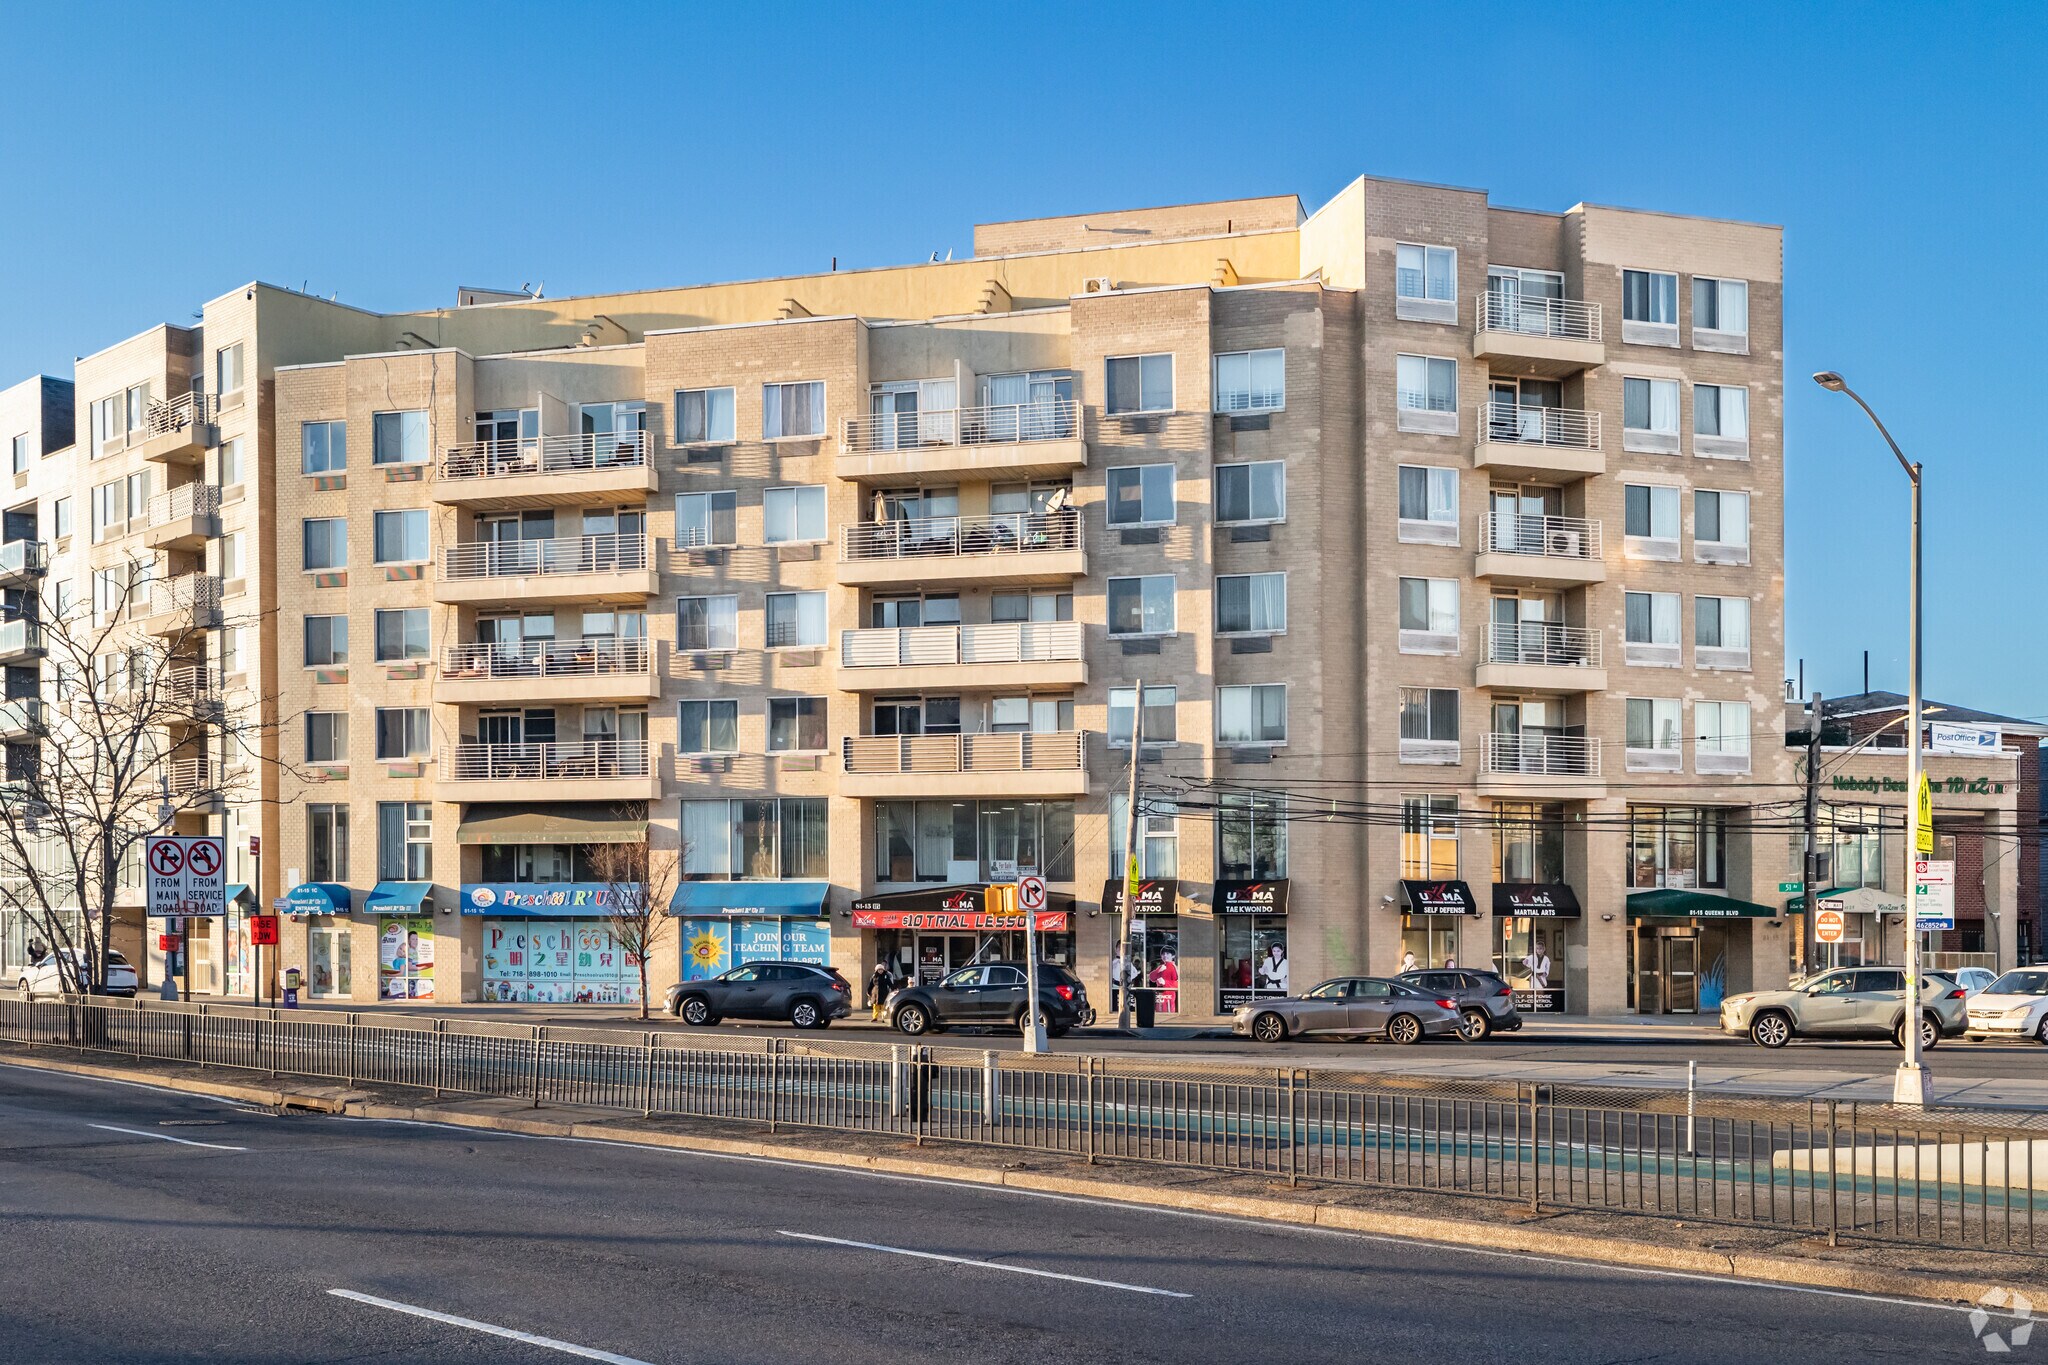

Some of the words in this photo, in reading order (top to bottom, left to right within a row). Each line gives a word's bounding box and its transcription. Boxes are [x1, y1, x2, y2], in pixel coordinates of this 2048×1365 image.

[1937, 733, 1954, 741] Post
[1954, 733, 1976, 742] Office
[1833, 775, 1880, 795] Nobody
[1946, 776, 2009, 796] WinZone
[155, 877, 180, 888] FROM
[193, 878, 218, 888] FROM
[1785, 883, 1792, 892] 51
[1918, 884, 1925, 894] 2
[156, 890, 180, 900] MAIN
[188, 890, 223, 900] SERVICE
[503, 889, 571, 907] Preschool
[156, 903, 181, 913] ROAD
[194, 903, 218, 913] ROAD
[1423, 906, 1438, 914] SELF
[1439, 906, 1465, 914] DEFENSE
[1514, 908, 1540, 916] MARTIAL
[902, 913, 924, 928] $10
[927, 914, 969, 929] TRIAL
[753, 932, 778, 943] JOIN
[783, 932, 807, 942] OUR
[733, 943, 790, 953] TEACHING
[795, 943, 825, 953] TEAM
